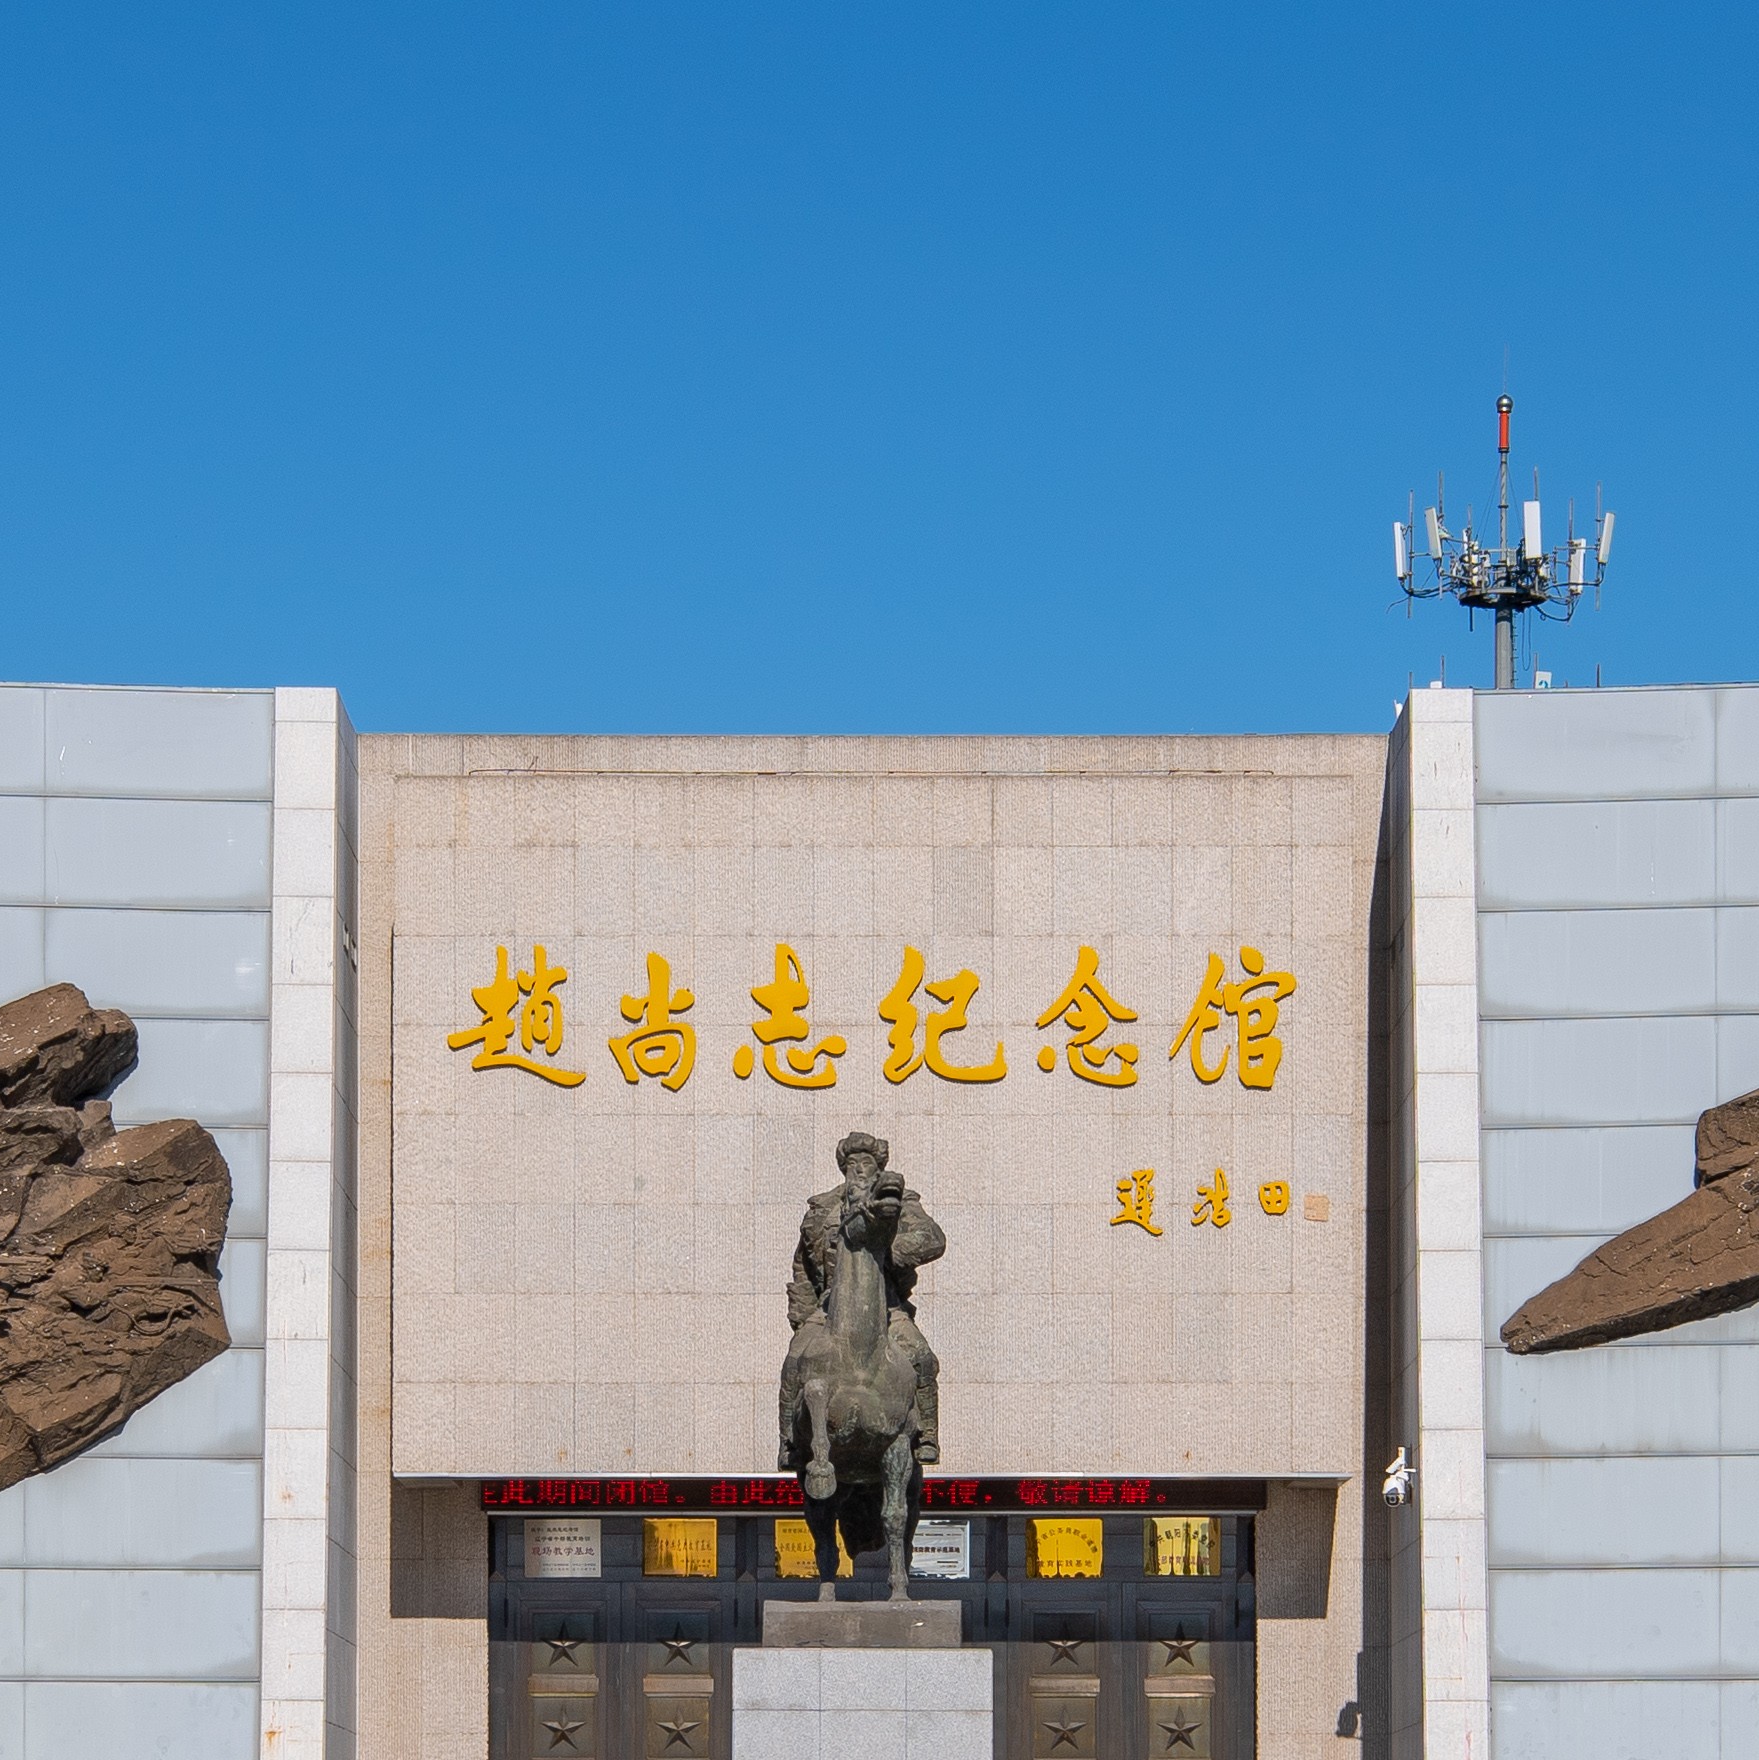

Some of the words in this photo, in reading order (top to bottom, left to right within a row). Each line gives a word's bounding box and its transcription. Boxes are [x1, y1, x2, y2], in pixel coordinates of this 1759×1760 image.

[531, 1546, 595, 1557] 现场教学基地
